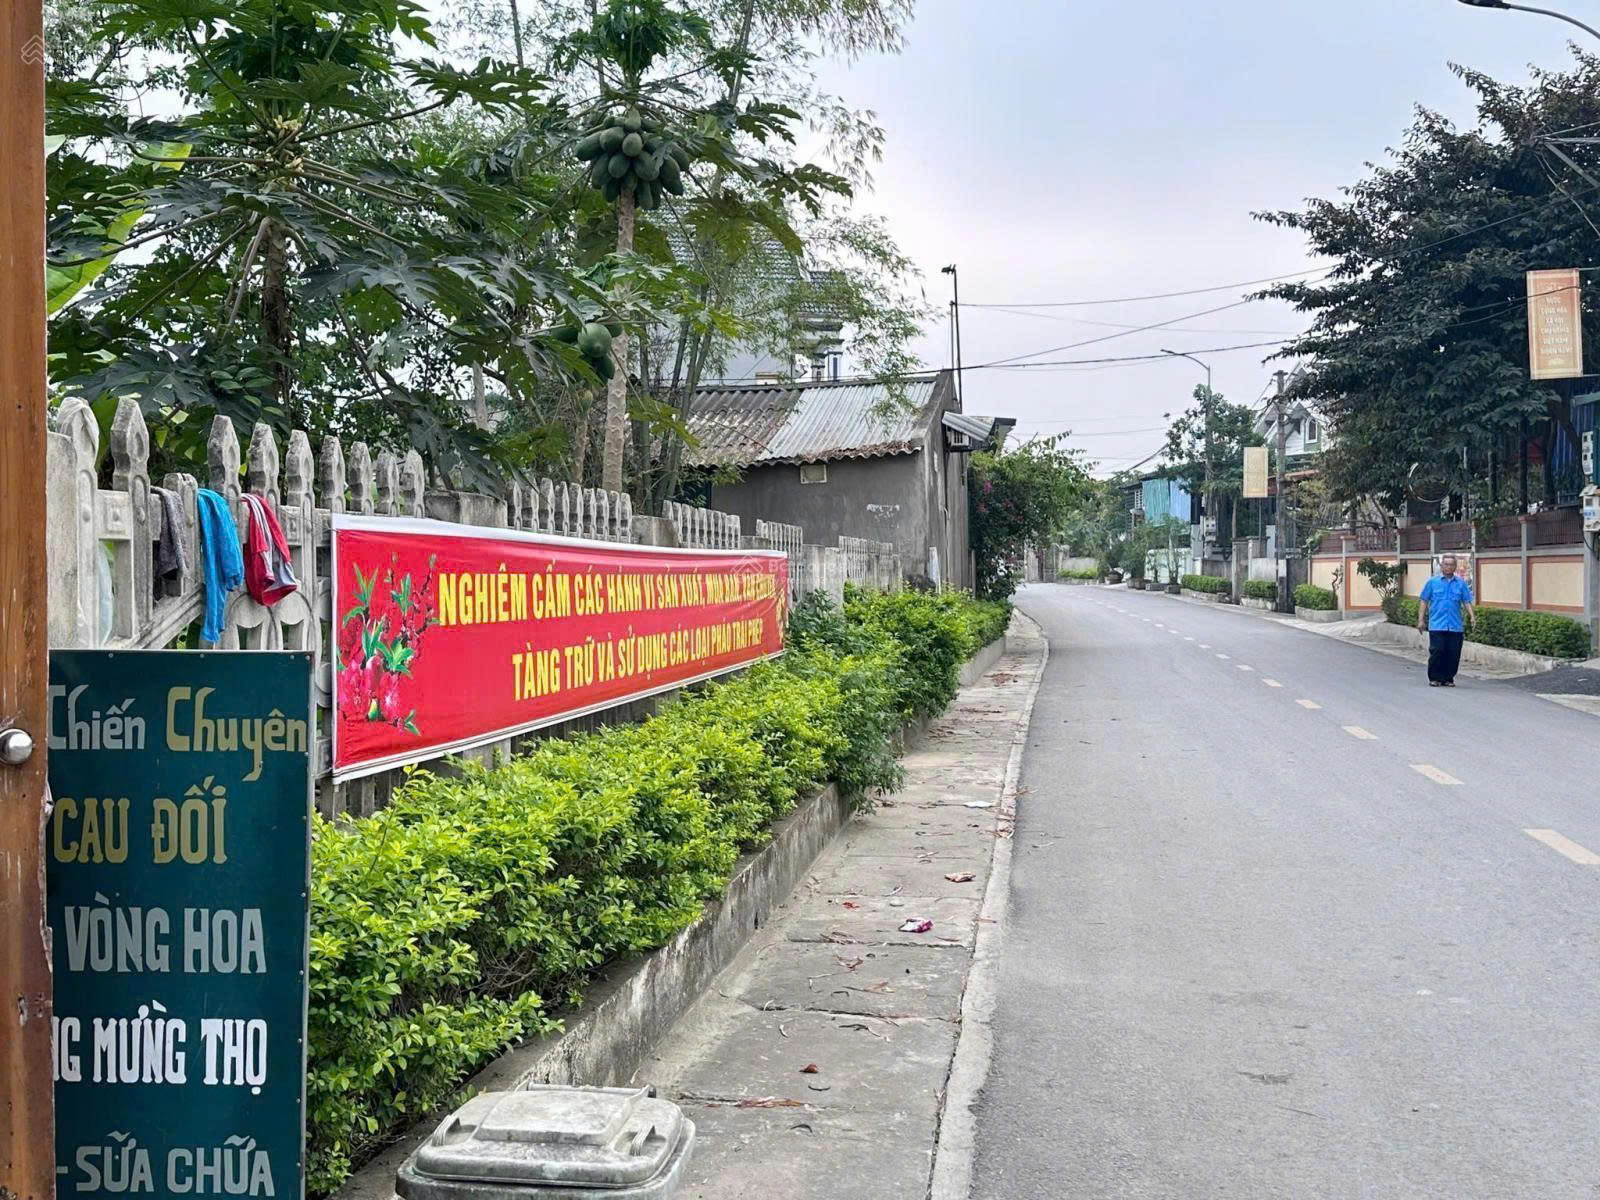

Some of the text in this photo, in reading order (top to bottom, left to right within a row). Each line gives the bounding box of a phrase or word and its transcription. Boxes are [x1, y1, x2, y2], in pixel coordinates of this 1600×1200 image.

[439, 563, 527, 626] NGHIÊM
[532, 560, 571, 619] CẤM
[574, 565, 604, 616] CÁC
[607, 565, 642, 613] HÀNH
[643, 574, 655, 610] VI
[657, 564, 679, 609] SẢN
[512, 642, 560, 700] TÀNG
[565, 635, 595, 690] TRỮ
[597, 632, 615, 682] VÀ
[618, 624, 635, 678] SỬ
[637, 632, 667, 680] DỤNG
[670, 623, 689, 666] CÁC
[690, 627, 710, 666] LOẠI
[711, 617, 731, 656] PHÁO
[47, 684, 307, 781] Chiến Chuyên
[151, 775, 228, 864] ĐỐI
[64, 891, 267, 974] VÒNG HOA
[93, 1000, 187, 1085] MỪNG
[200, 1018, 267, 1095] THỌ
[167, 1133, 275, 1197] CHỮA
